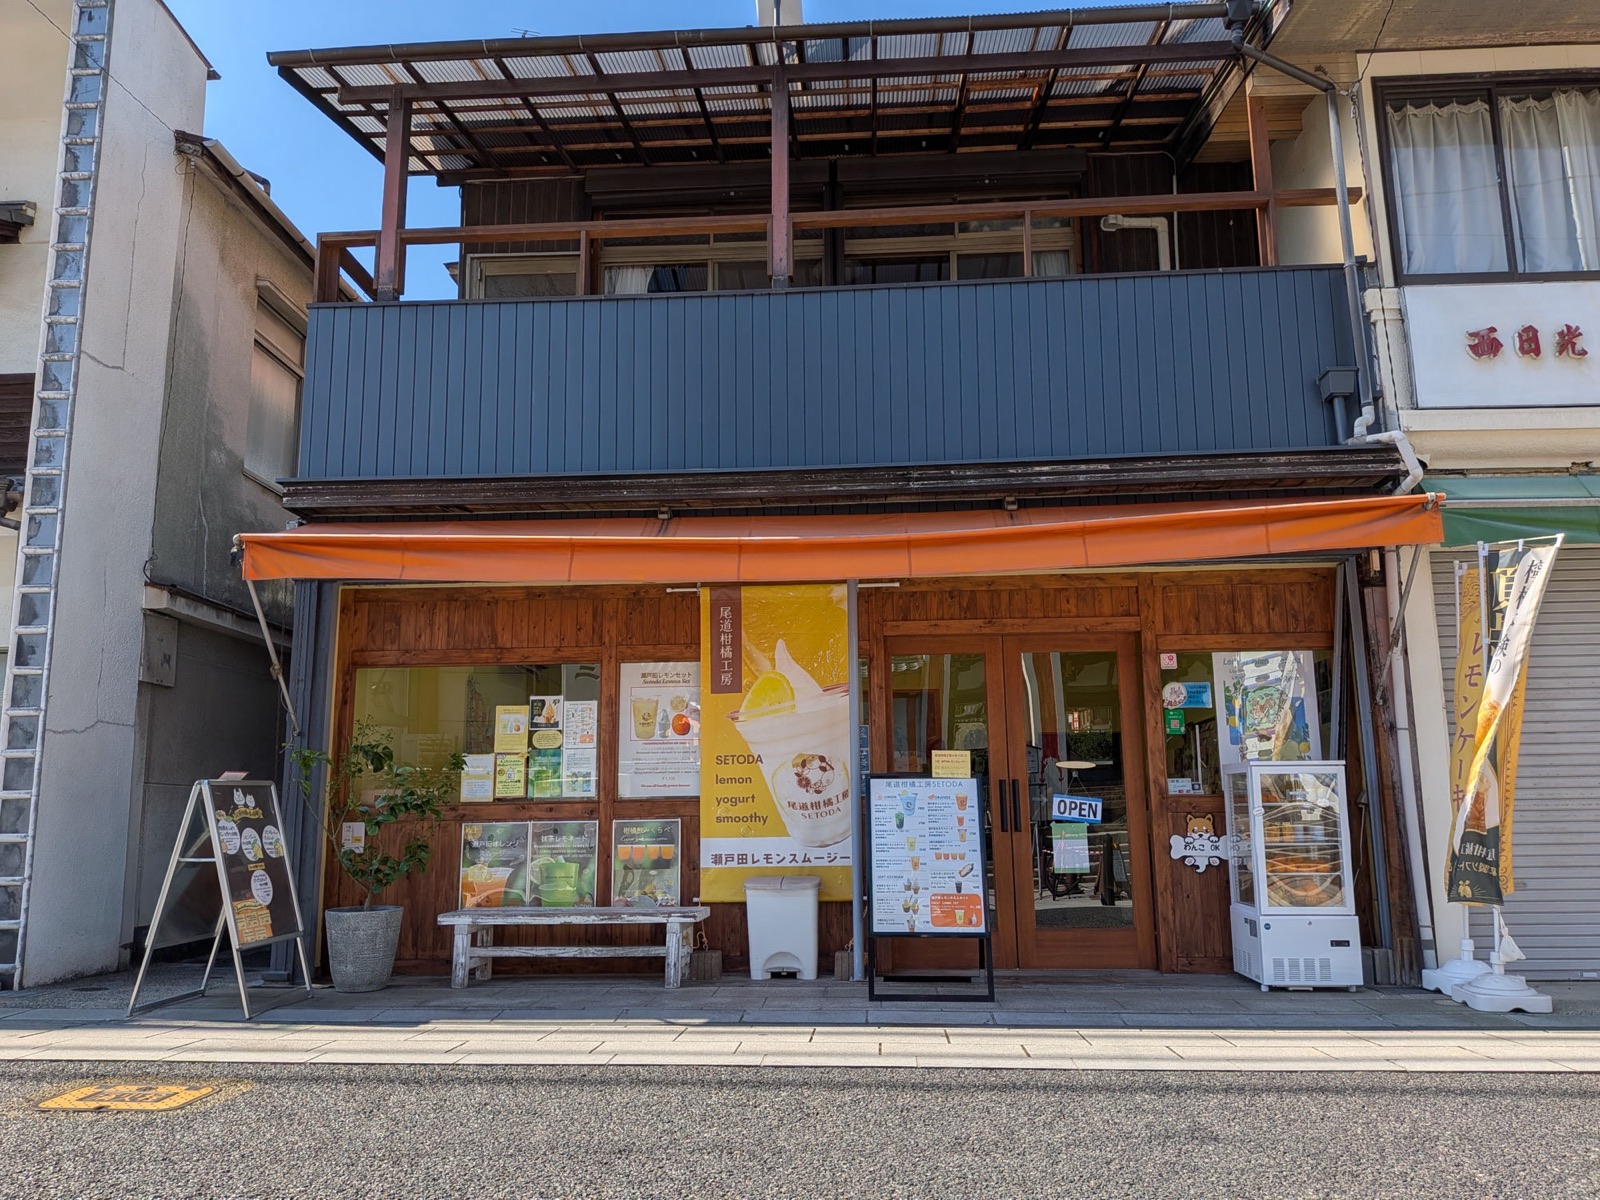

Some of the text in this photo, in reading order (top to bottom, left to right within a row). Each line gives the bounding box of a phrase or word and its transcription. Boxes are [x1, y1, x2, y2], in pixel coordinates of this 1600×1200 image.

[719, 606, 733, 686] 尾道柑橘工房
[715, 754, 764, 766] SETODA
[715, 774, 752, 786] lemon
[715, 794, 756, 807] yogurt
[800, 807, 842, 820] SETODA
[1057, 799, 1099, 819] OPEN
[715, 812, 769, 826] smoothy
[1183, 843, 1221, 852] わんこ OK
[710, 852, 851, 867] 瀬戸田レモンスムージー
